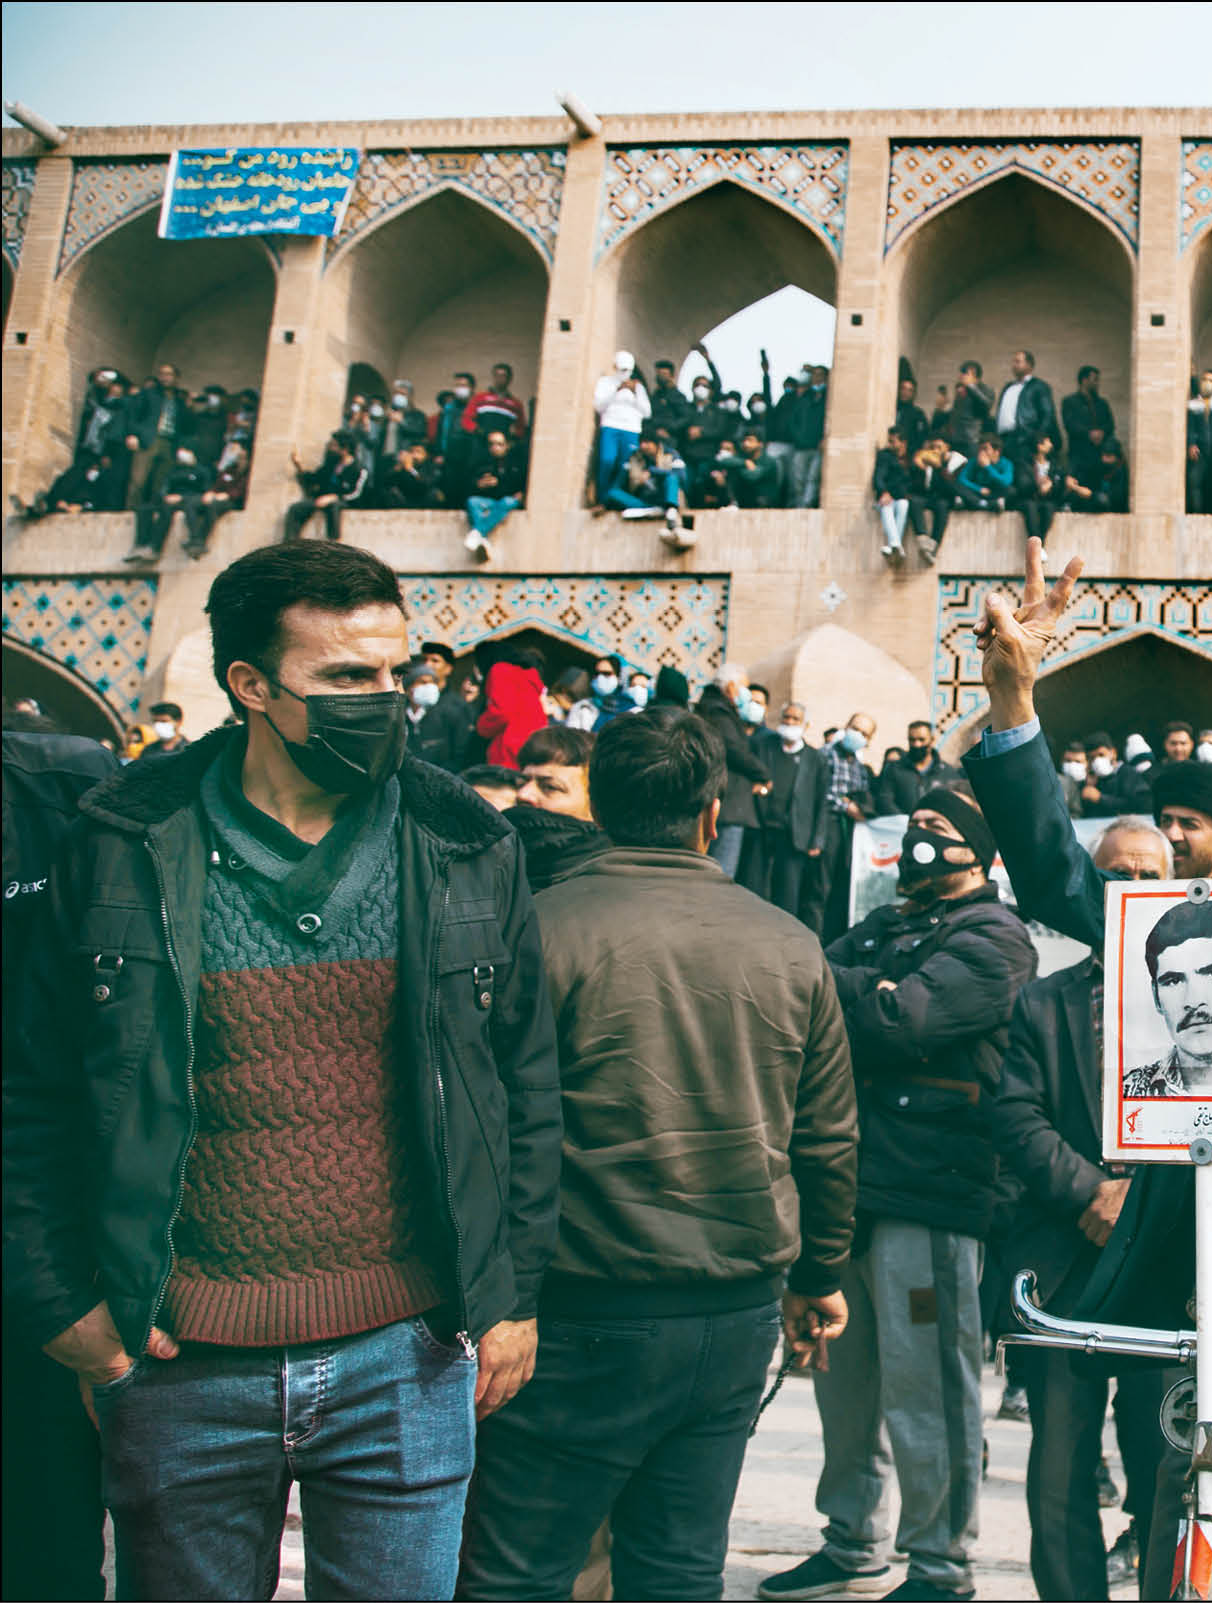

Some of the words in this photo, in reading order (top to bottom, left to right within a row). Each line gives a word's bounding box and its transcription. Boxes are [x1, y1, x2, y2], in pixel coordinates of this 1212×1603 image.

[267, 151, 298, 169] رود
[175, 173, 204, 190] شده
[206, 172, 244, 189] خشک
[200, 193, 260, 217] اصفهان
[21, 878, 48, 893] asic
